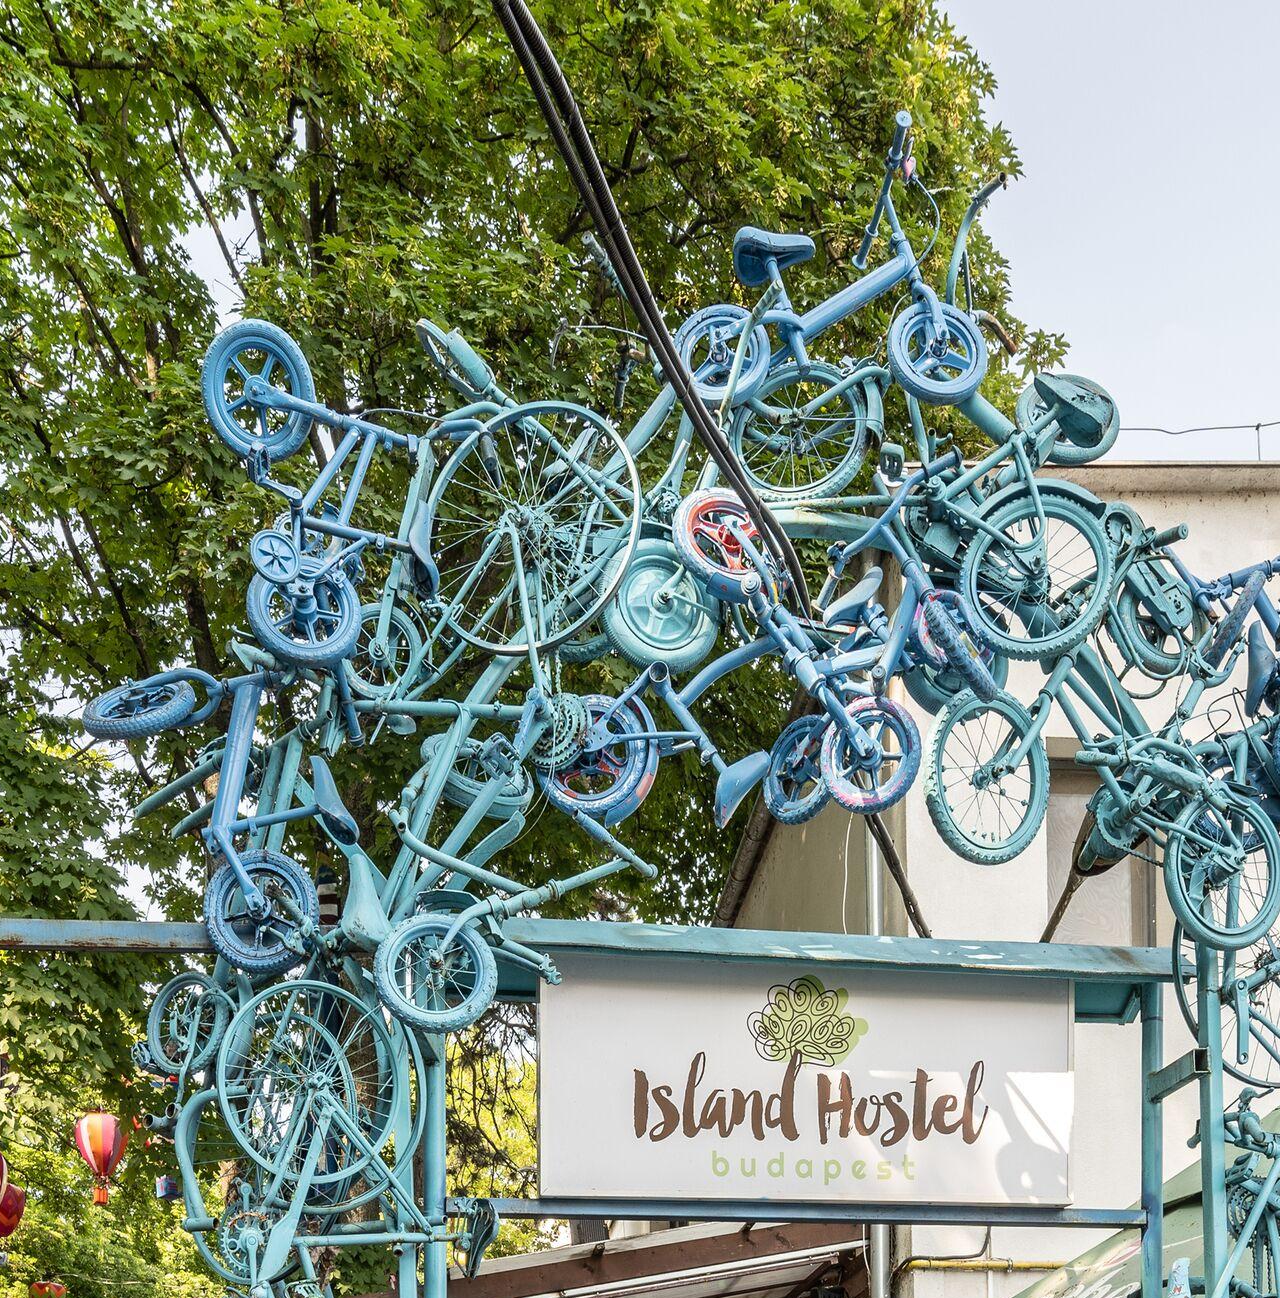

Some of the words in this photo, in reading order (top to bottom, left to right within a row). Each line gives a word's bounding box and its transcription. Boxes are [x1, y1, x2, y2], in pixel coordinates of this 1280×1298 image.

[633, 1050, 800, 1143] Island
[819, 1061, 988, 1146] Hostel
[712, 1150, 916, 1185] budapest
